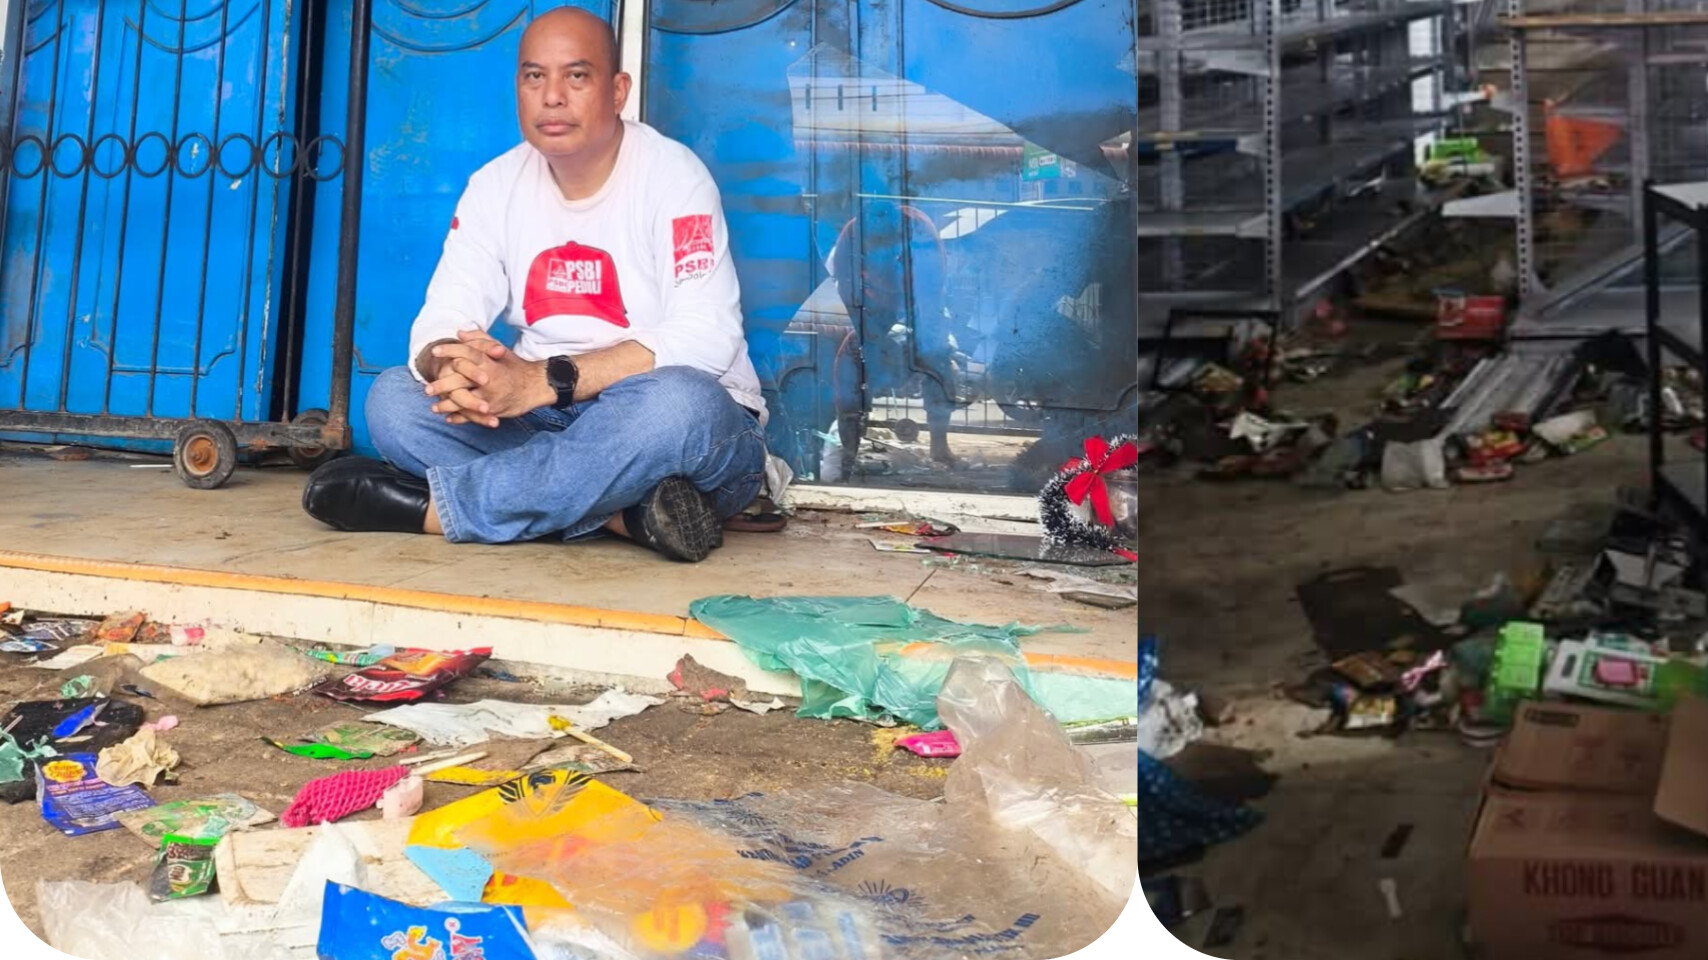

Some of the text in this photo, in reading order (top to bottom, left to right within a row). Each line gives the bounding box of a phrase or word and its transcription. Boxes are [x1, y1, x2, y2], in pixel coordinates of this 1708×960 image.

[565, 260, 602, 281] PSBI
[1523, 861, 1706, 902] KHONG GUAN
